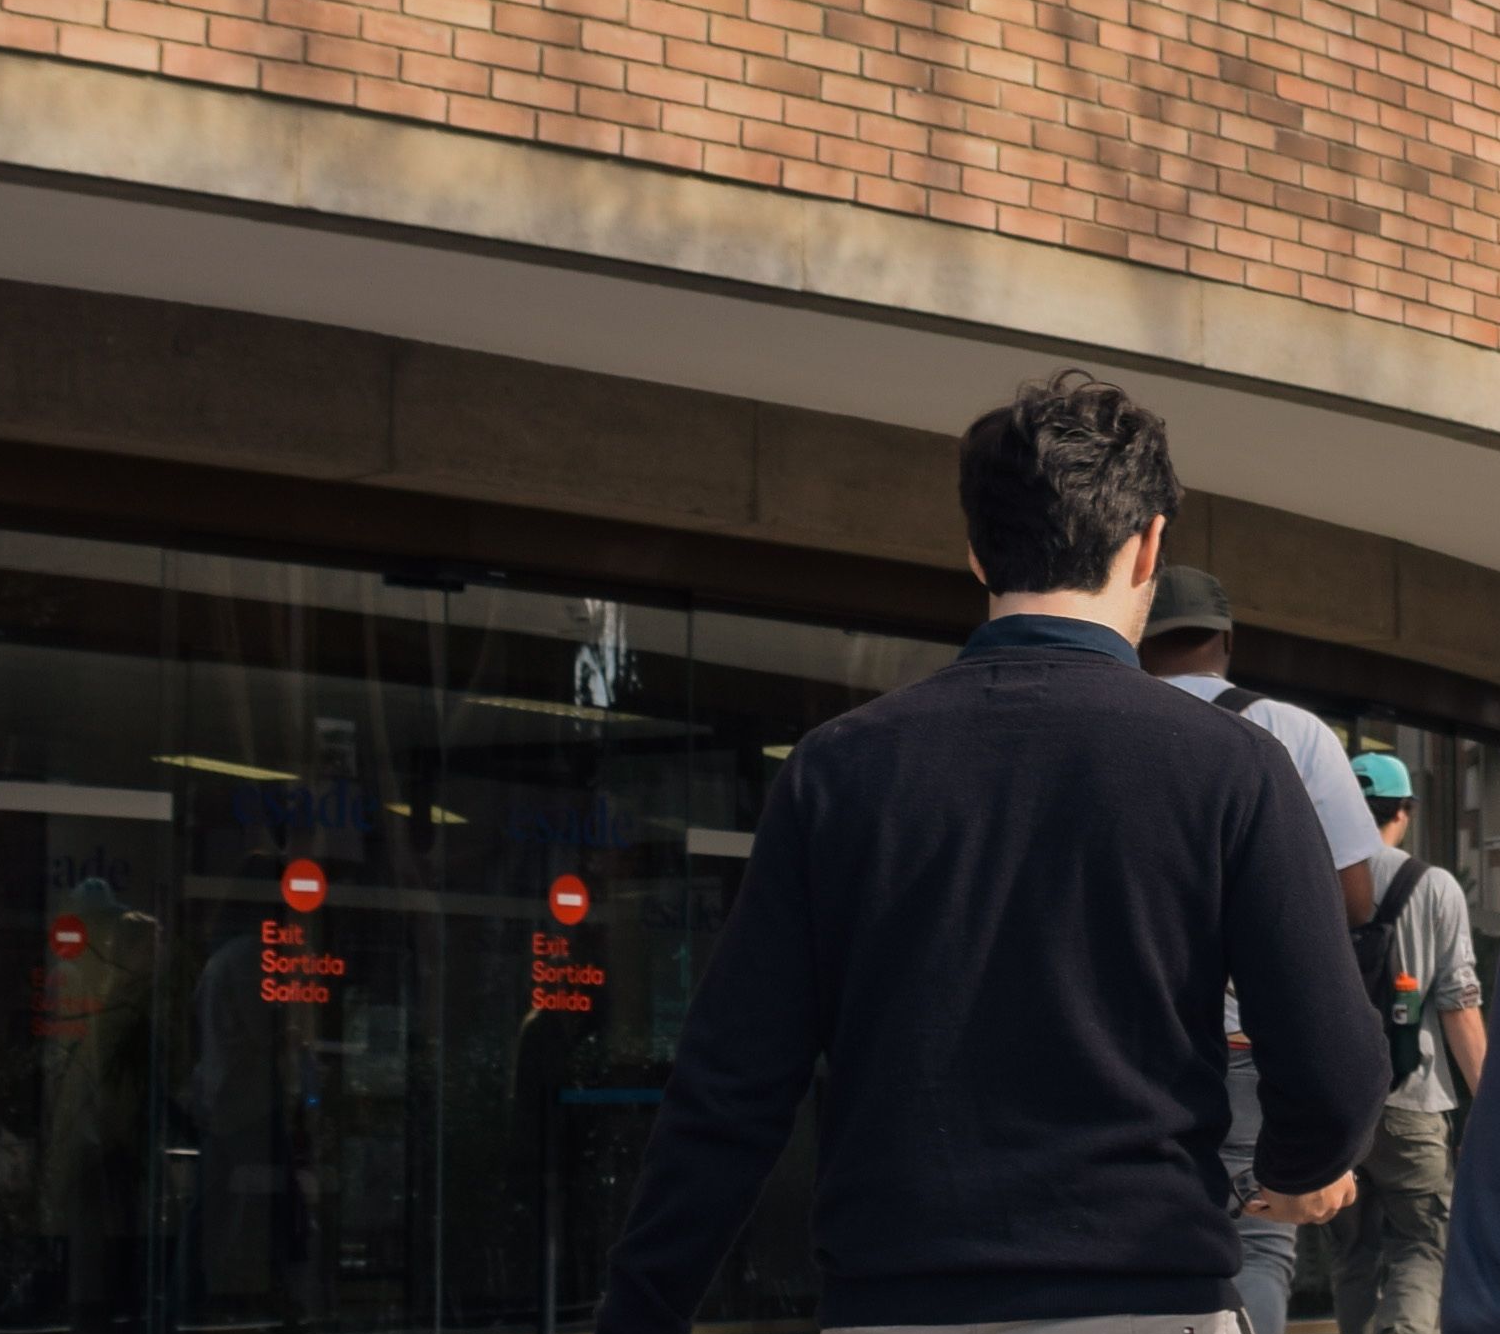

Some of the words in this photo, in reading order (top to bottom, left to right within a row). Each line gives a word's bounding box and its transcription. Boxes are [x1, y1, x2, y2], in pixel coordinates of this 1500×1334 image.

[230, 778, 379, 832] esade
[506, 795, 635, 849] esade
[260, 918, 305, 946] Exit
[531, 931, 571, 958] Exit
[260, 950, 347, 977] Sortida
[531, 961, 606, 987] Sortida
[260, 977, 331, 1004] Salida
[531, 986, 593, 1013] Salida
